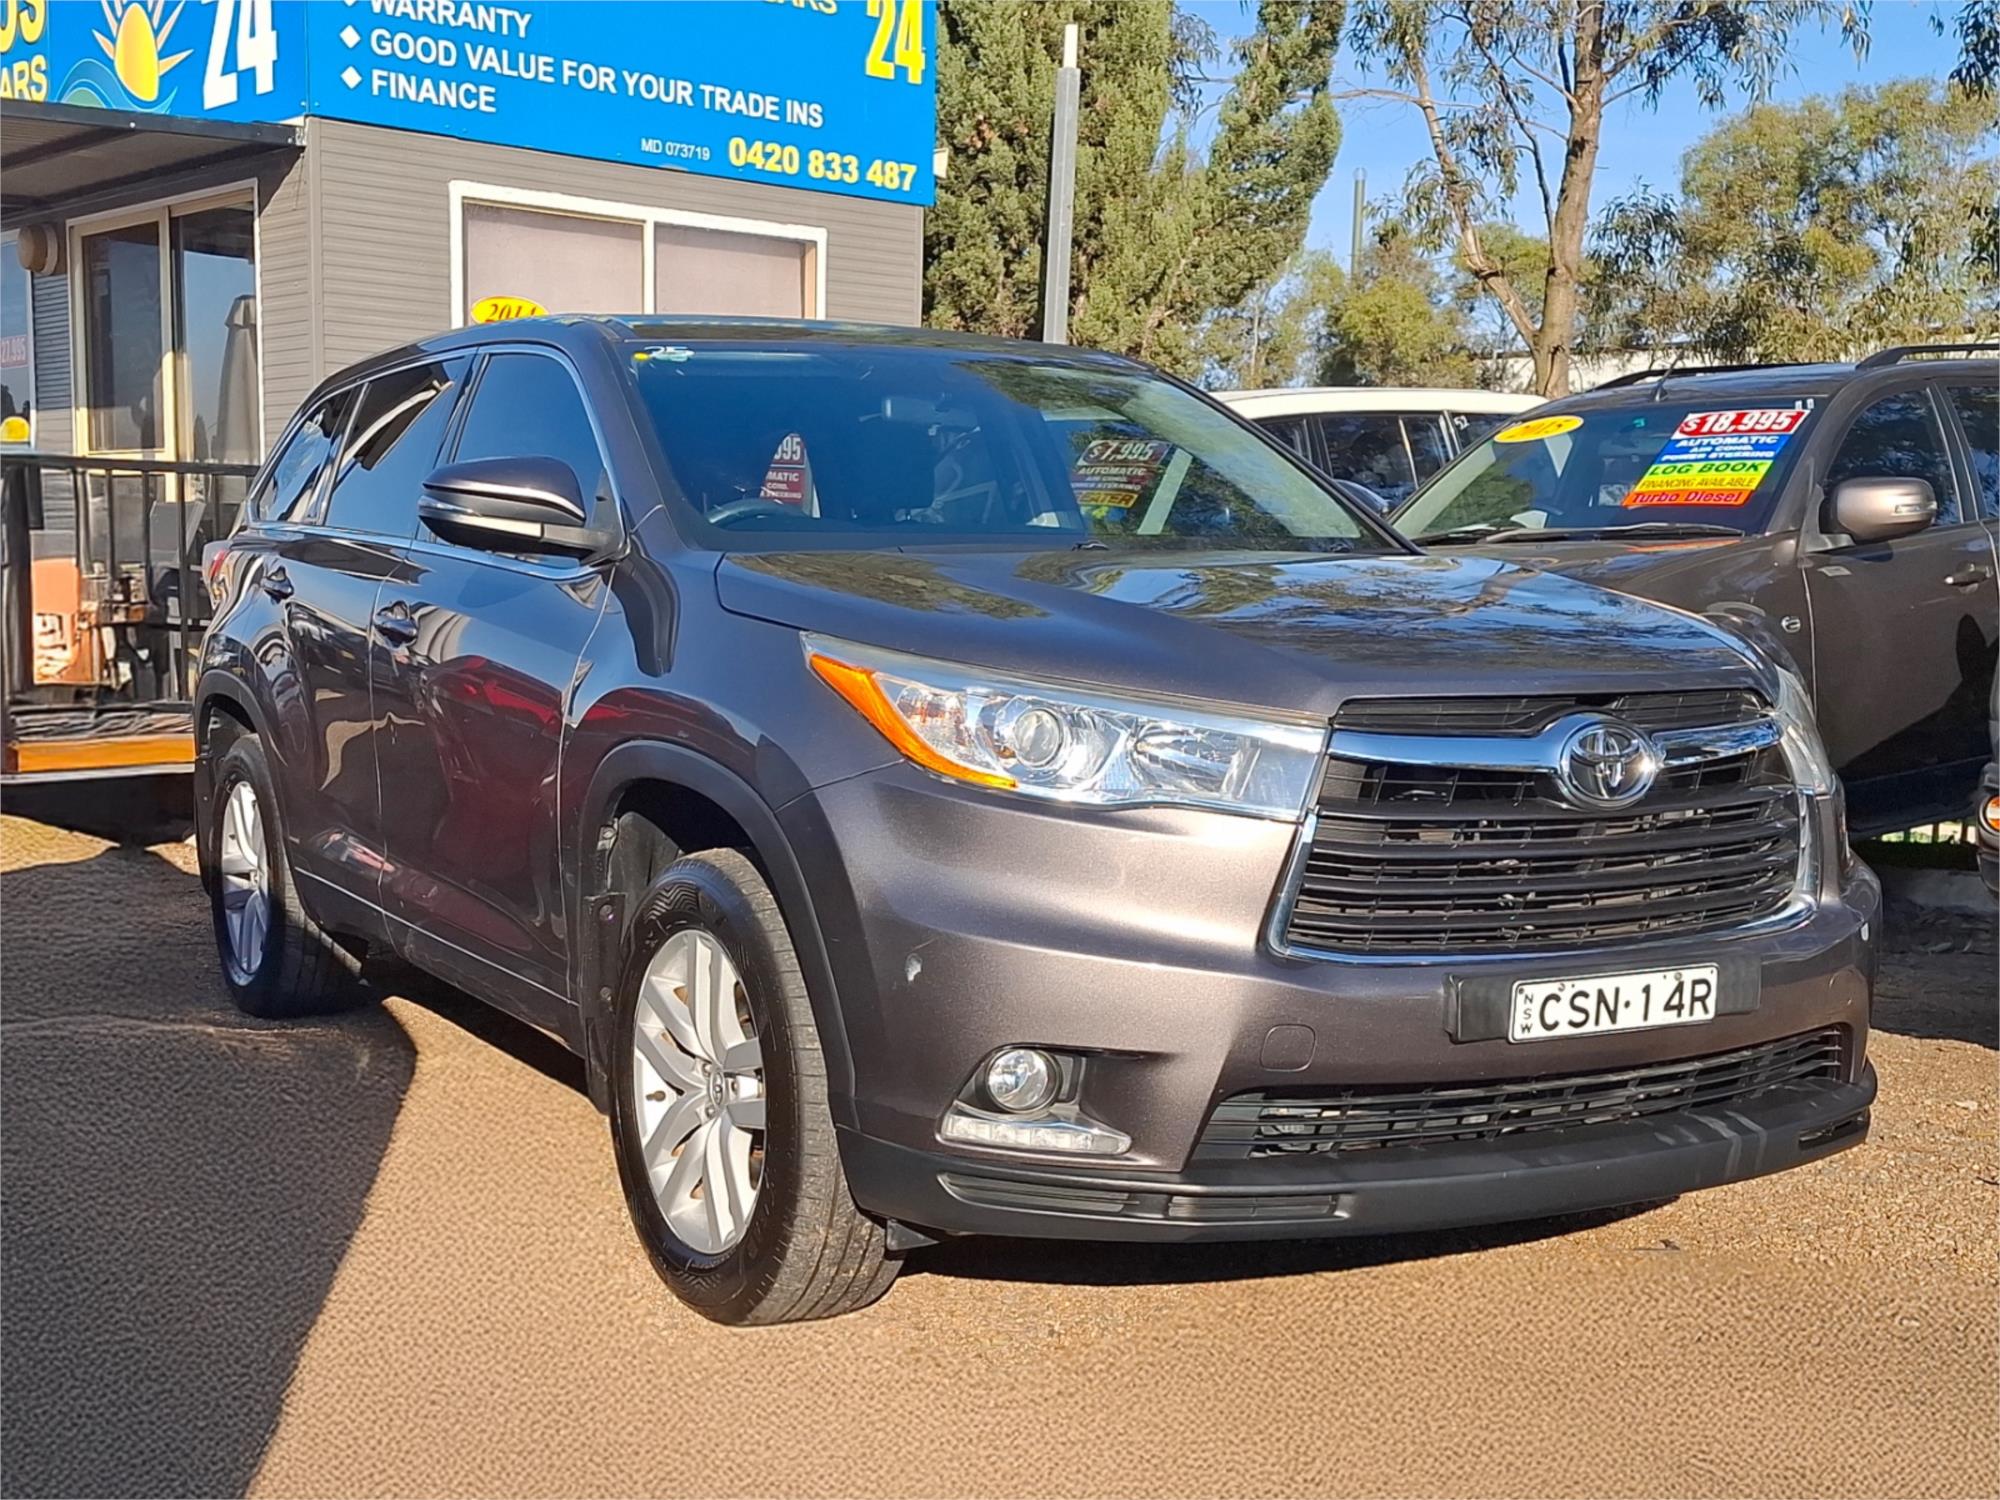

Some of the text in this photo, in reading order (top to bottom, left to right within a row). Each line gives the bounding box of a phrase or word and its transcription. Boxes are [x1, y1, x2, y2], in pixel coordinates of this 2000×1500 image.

[371, 0, 532, 38] WARRANTY
[865, 0, 925, 85] 24
[370, 28, 824, 128] GOOD VALUE FOR YOUR TRADE INS
[371, 69, 497, 113] FINANCE
[641, 138, 710, 161] MD 073719
[728, 137, 917, 191] 0420 833 487
[1681, 411, 1798, 433] $18,995
[1675, 436, 1779, 448] AUTOMATIC
[1649, 462, 1768, 476] LOG BOOK
[1640, 477, 1757, 489] FINANCING AVAILABLE
[1632, 491, 1743, 503] Turbo Diesel
